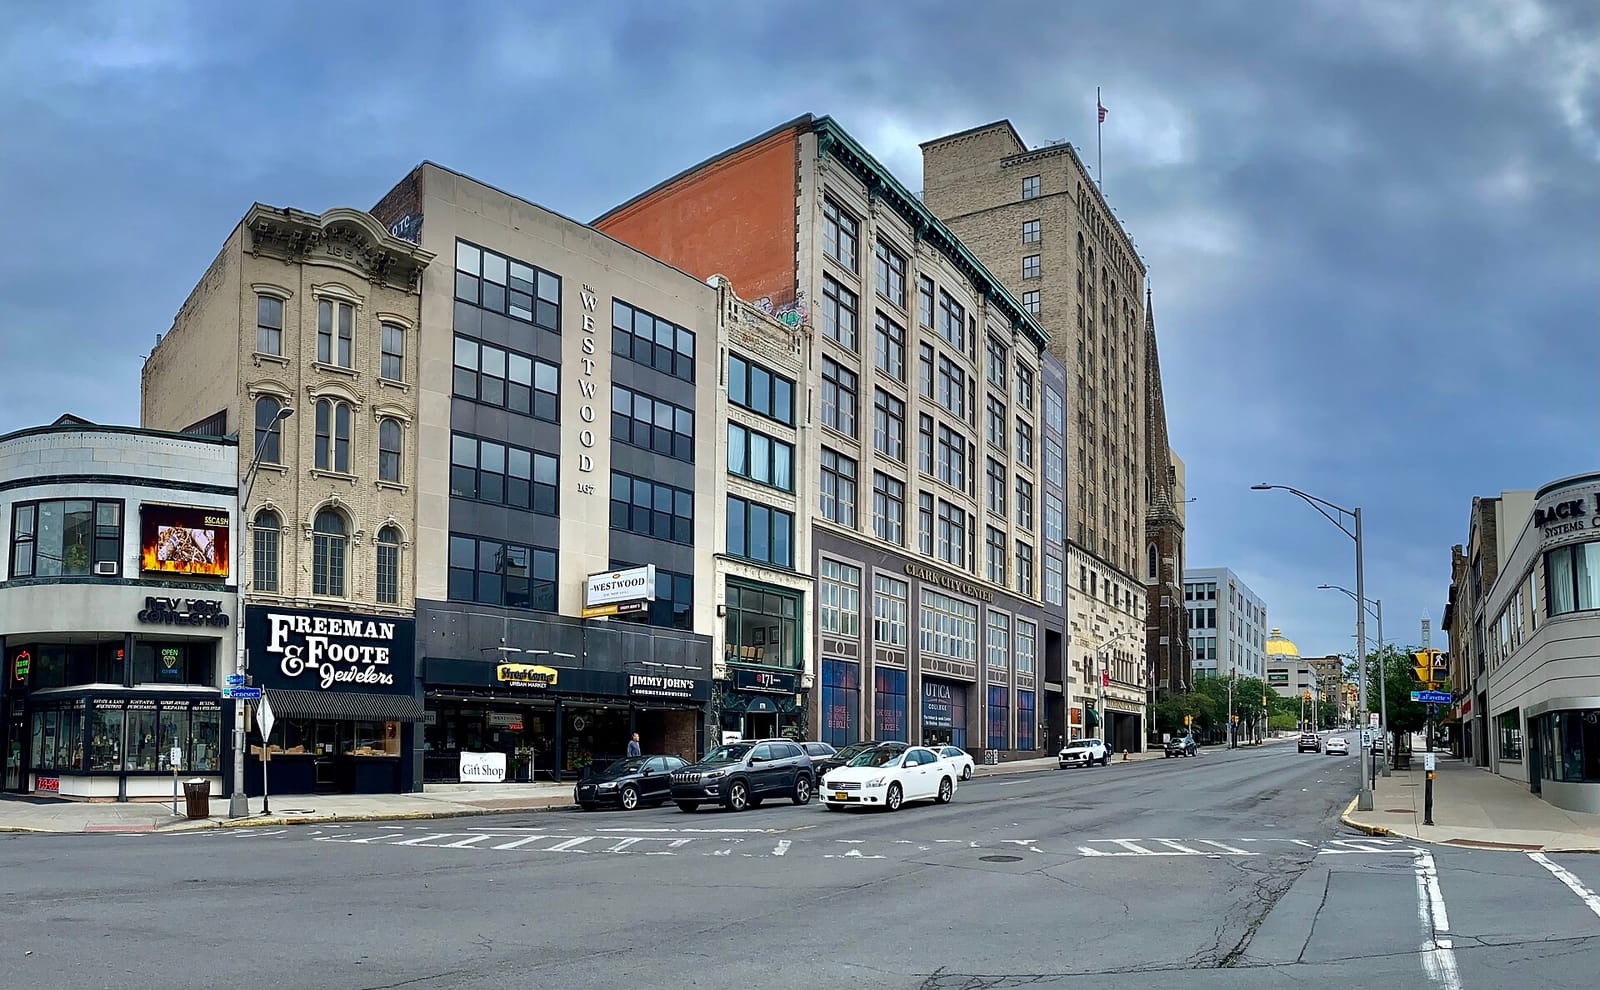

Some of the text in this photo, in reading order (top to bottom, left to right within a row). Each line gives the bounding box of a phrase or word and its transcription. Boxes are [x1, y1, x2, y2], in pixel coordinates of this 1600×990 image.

[578, 291, 598, 473] WESTWOOD
[577, 483, 595, 495] 167
[1544, 520, 1584, 538] SYSTEMS
[593, 577, 645, 592] WESTWOOD
[904, 562, 994, 602] CLARK CITY CENTER
[185, 598, 223, 613] YORK
[266, 613, 396, 653] FREEMAN
[161, 648, 179, 656] OPEN
[280, 635, 390, 677] & FOOTE
[319, 662, 394, 689] Jewelers
[501, 667, 527, 680] Street
[761, 673, 774, 687] 171
[629, 675, 694, 689] JIMMY JOHN'S
[925, 682, 951, 699] UTICA
[928, 703, 948, 711] COLLEGE
[462, 763, 504, 779] Gift Shop
